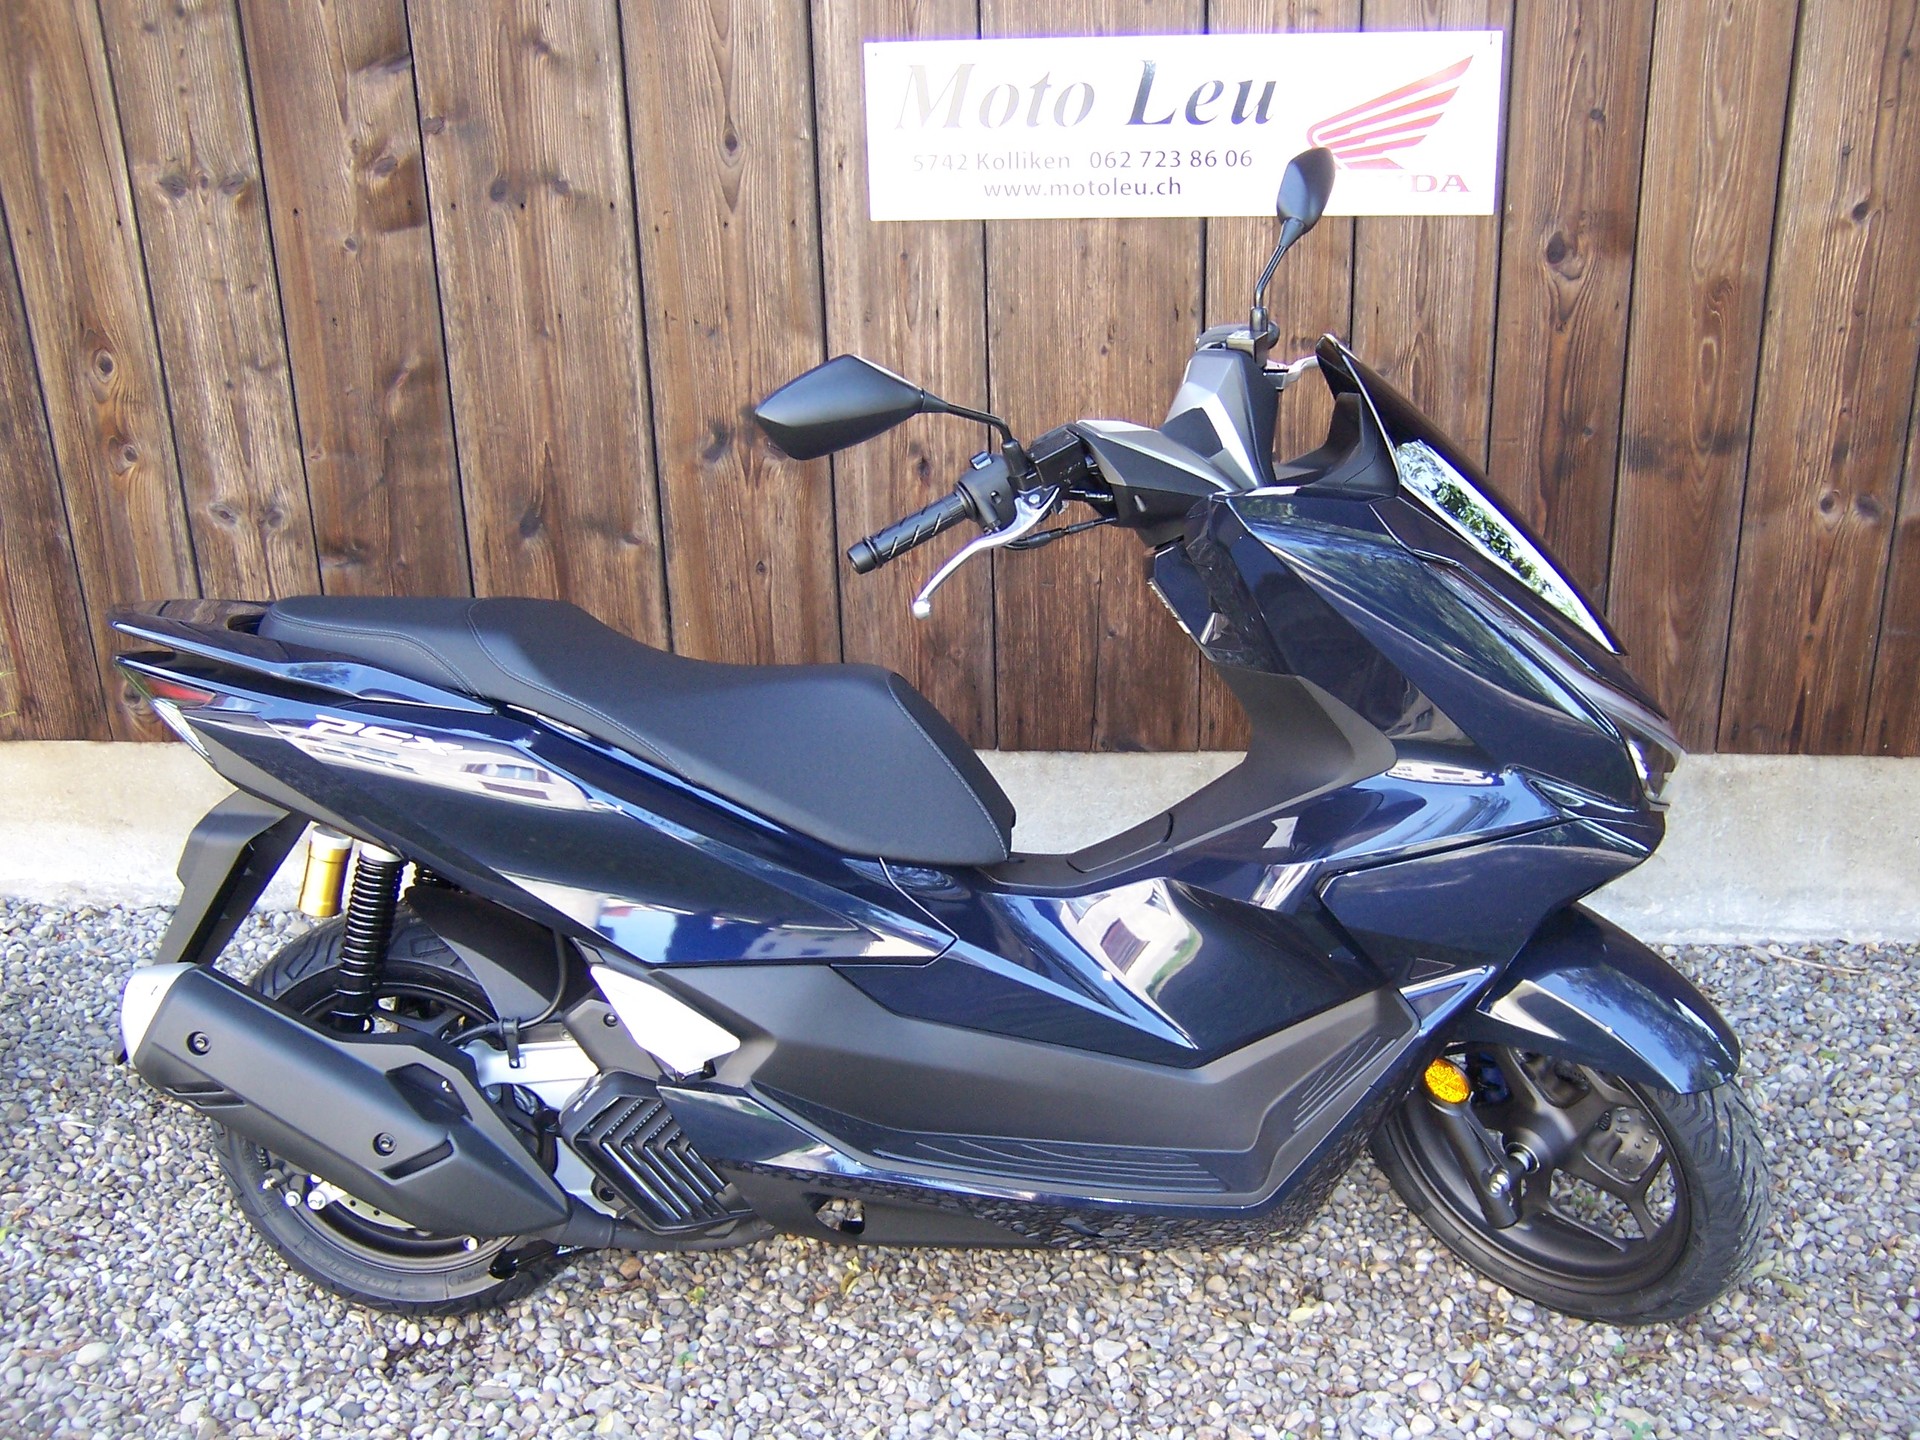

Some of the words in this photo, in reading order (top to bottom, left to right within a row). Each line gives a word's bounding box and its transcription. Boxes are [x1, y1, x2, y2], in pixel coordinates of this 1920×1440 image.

[895, 63, 1095, 130] Moto
[1125, 59, 1277, 126] Leu
[914, 153, 969, 172] 5742
[1090, 150, 1131, 169] 062
[1140, 150, 1181, 169] 723
[1189, 149, 1218, 168] 86
[1225, 149, 1253, 168] 06
[984, 176, 1181, 197] www.motoleu.ch
[308, 713, 464, 757] PCX
